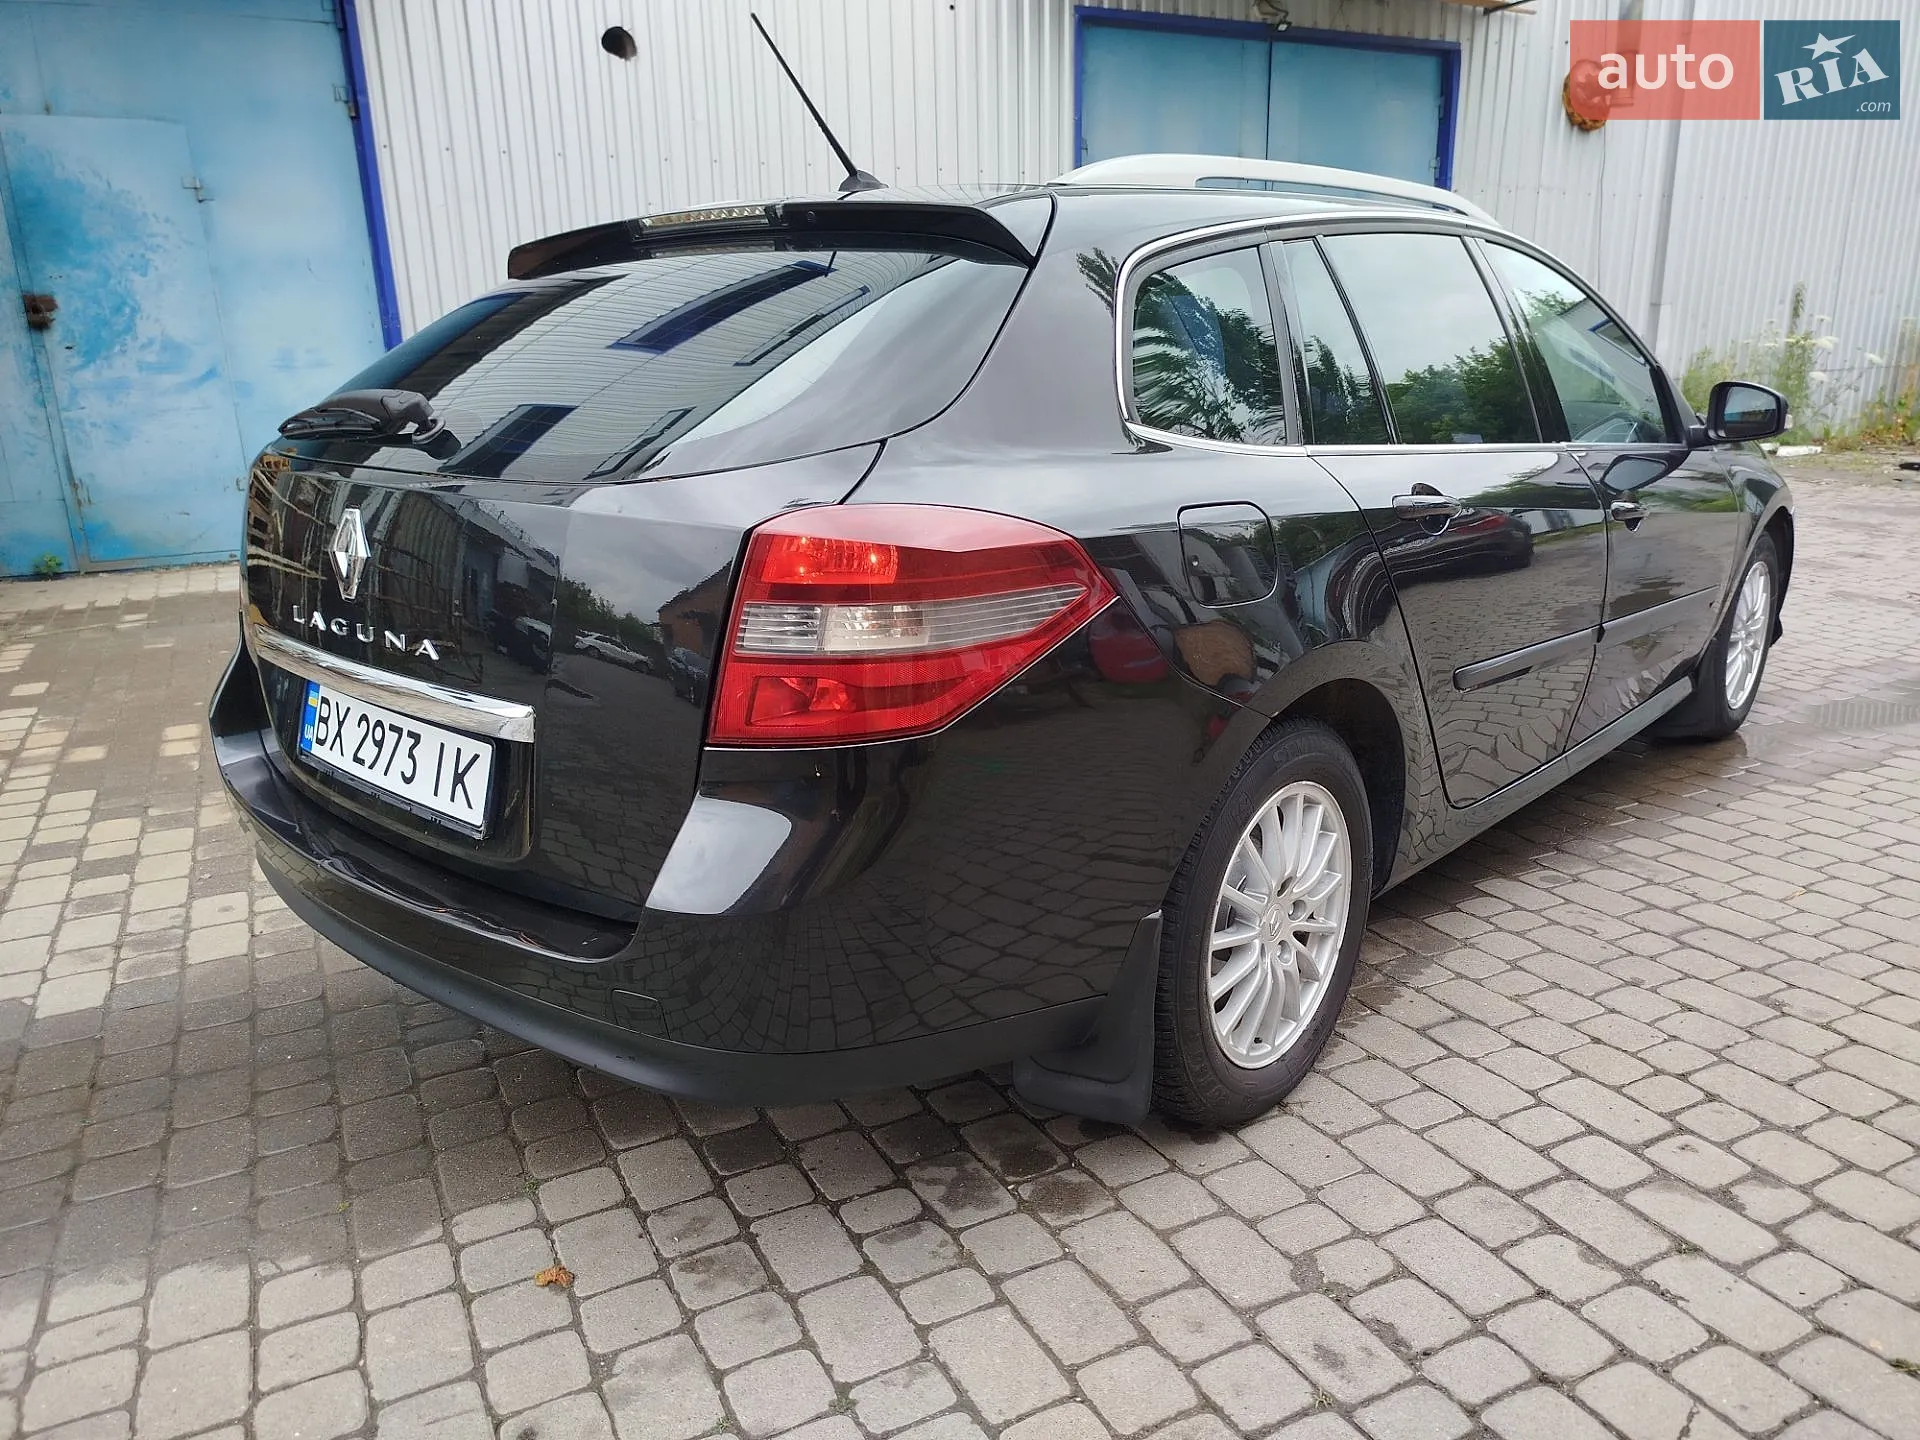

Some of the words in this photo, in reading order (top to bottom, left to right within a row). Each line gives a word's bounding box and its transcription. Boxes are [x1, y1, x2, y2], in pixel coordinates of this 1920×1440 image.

[292, 605, 440, 661] LAGUNA
[304, 723, 315, 742] UA
[315, 695, 351, 757] BX
[352, 713, 422, 785] 2973
[433, 741, 481, 810] IK
